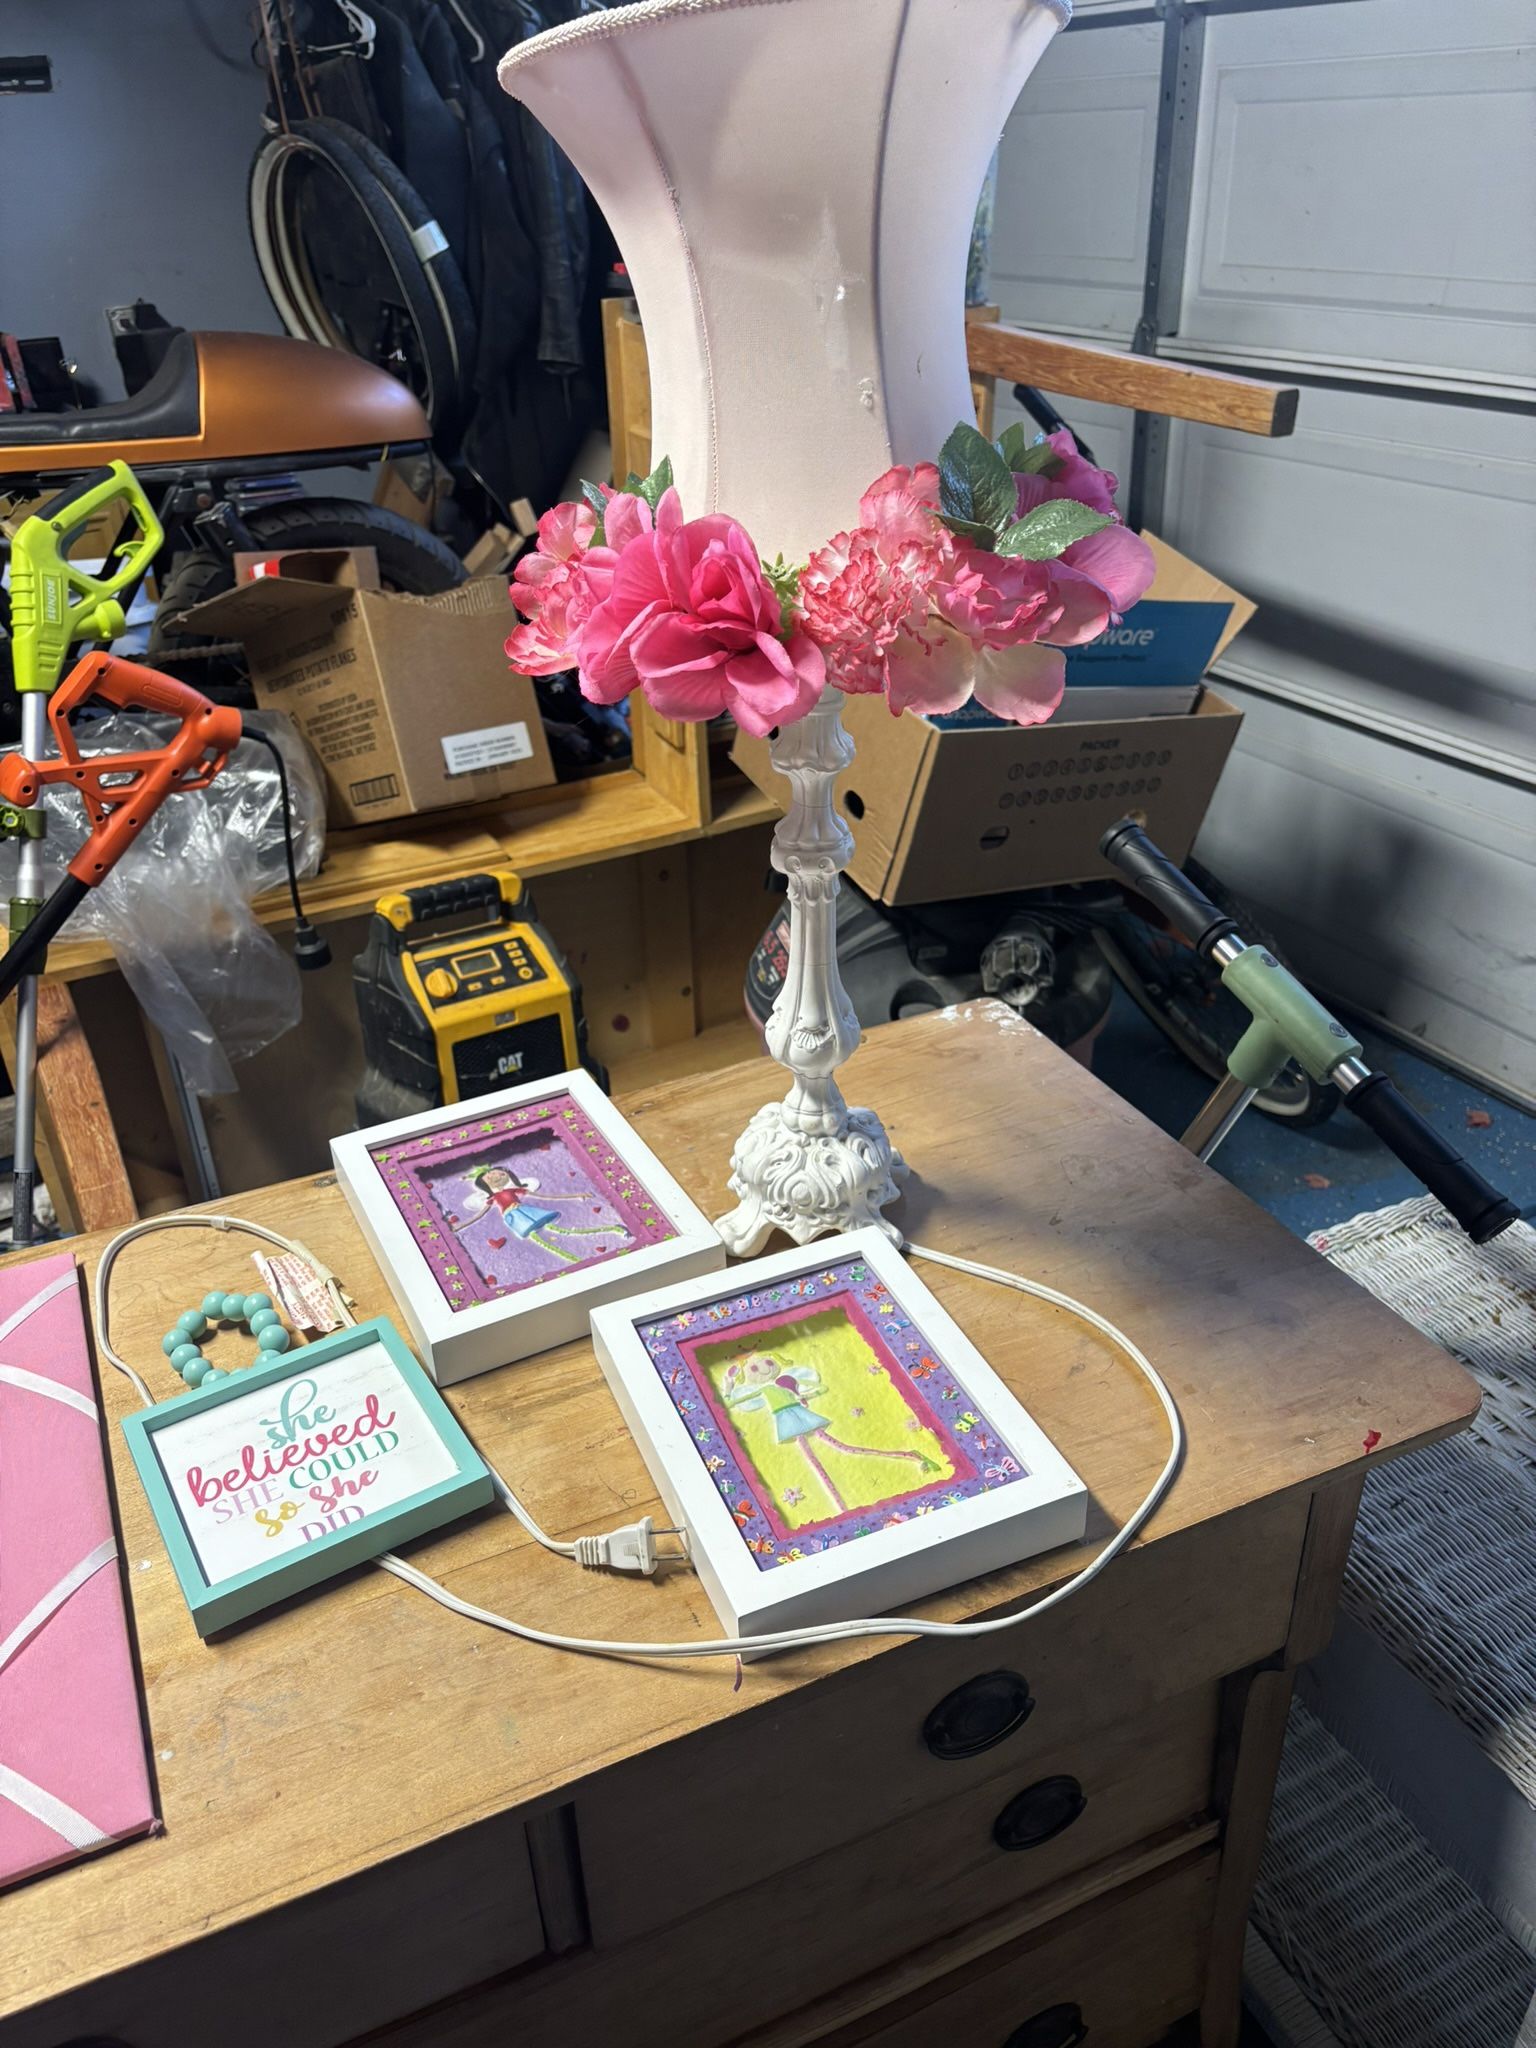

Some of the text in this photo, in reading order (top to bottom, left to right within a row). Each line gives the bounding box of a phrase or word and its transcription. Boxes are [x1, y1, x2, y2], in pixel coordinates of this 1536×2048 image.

[304, 657, 331, 677] POTATO
[331, 648, 357, 669] FLAKES
[498, 1052, 524, 1074] CAT
[259, 1379, 336, 1449] she
[187, 1394, 396, 1507] believed
[212, 1430, 399, 1524] SHE COULD
[255, 1470, 379, 1538] so she
[298, 1505, 365, 1543] DID
